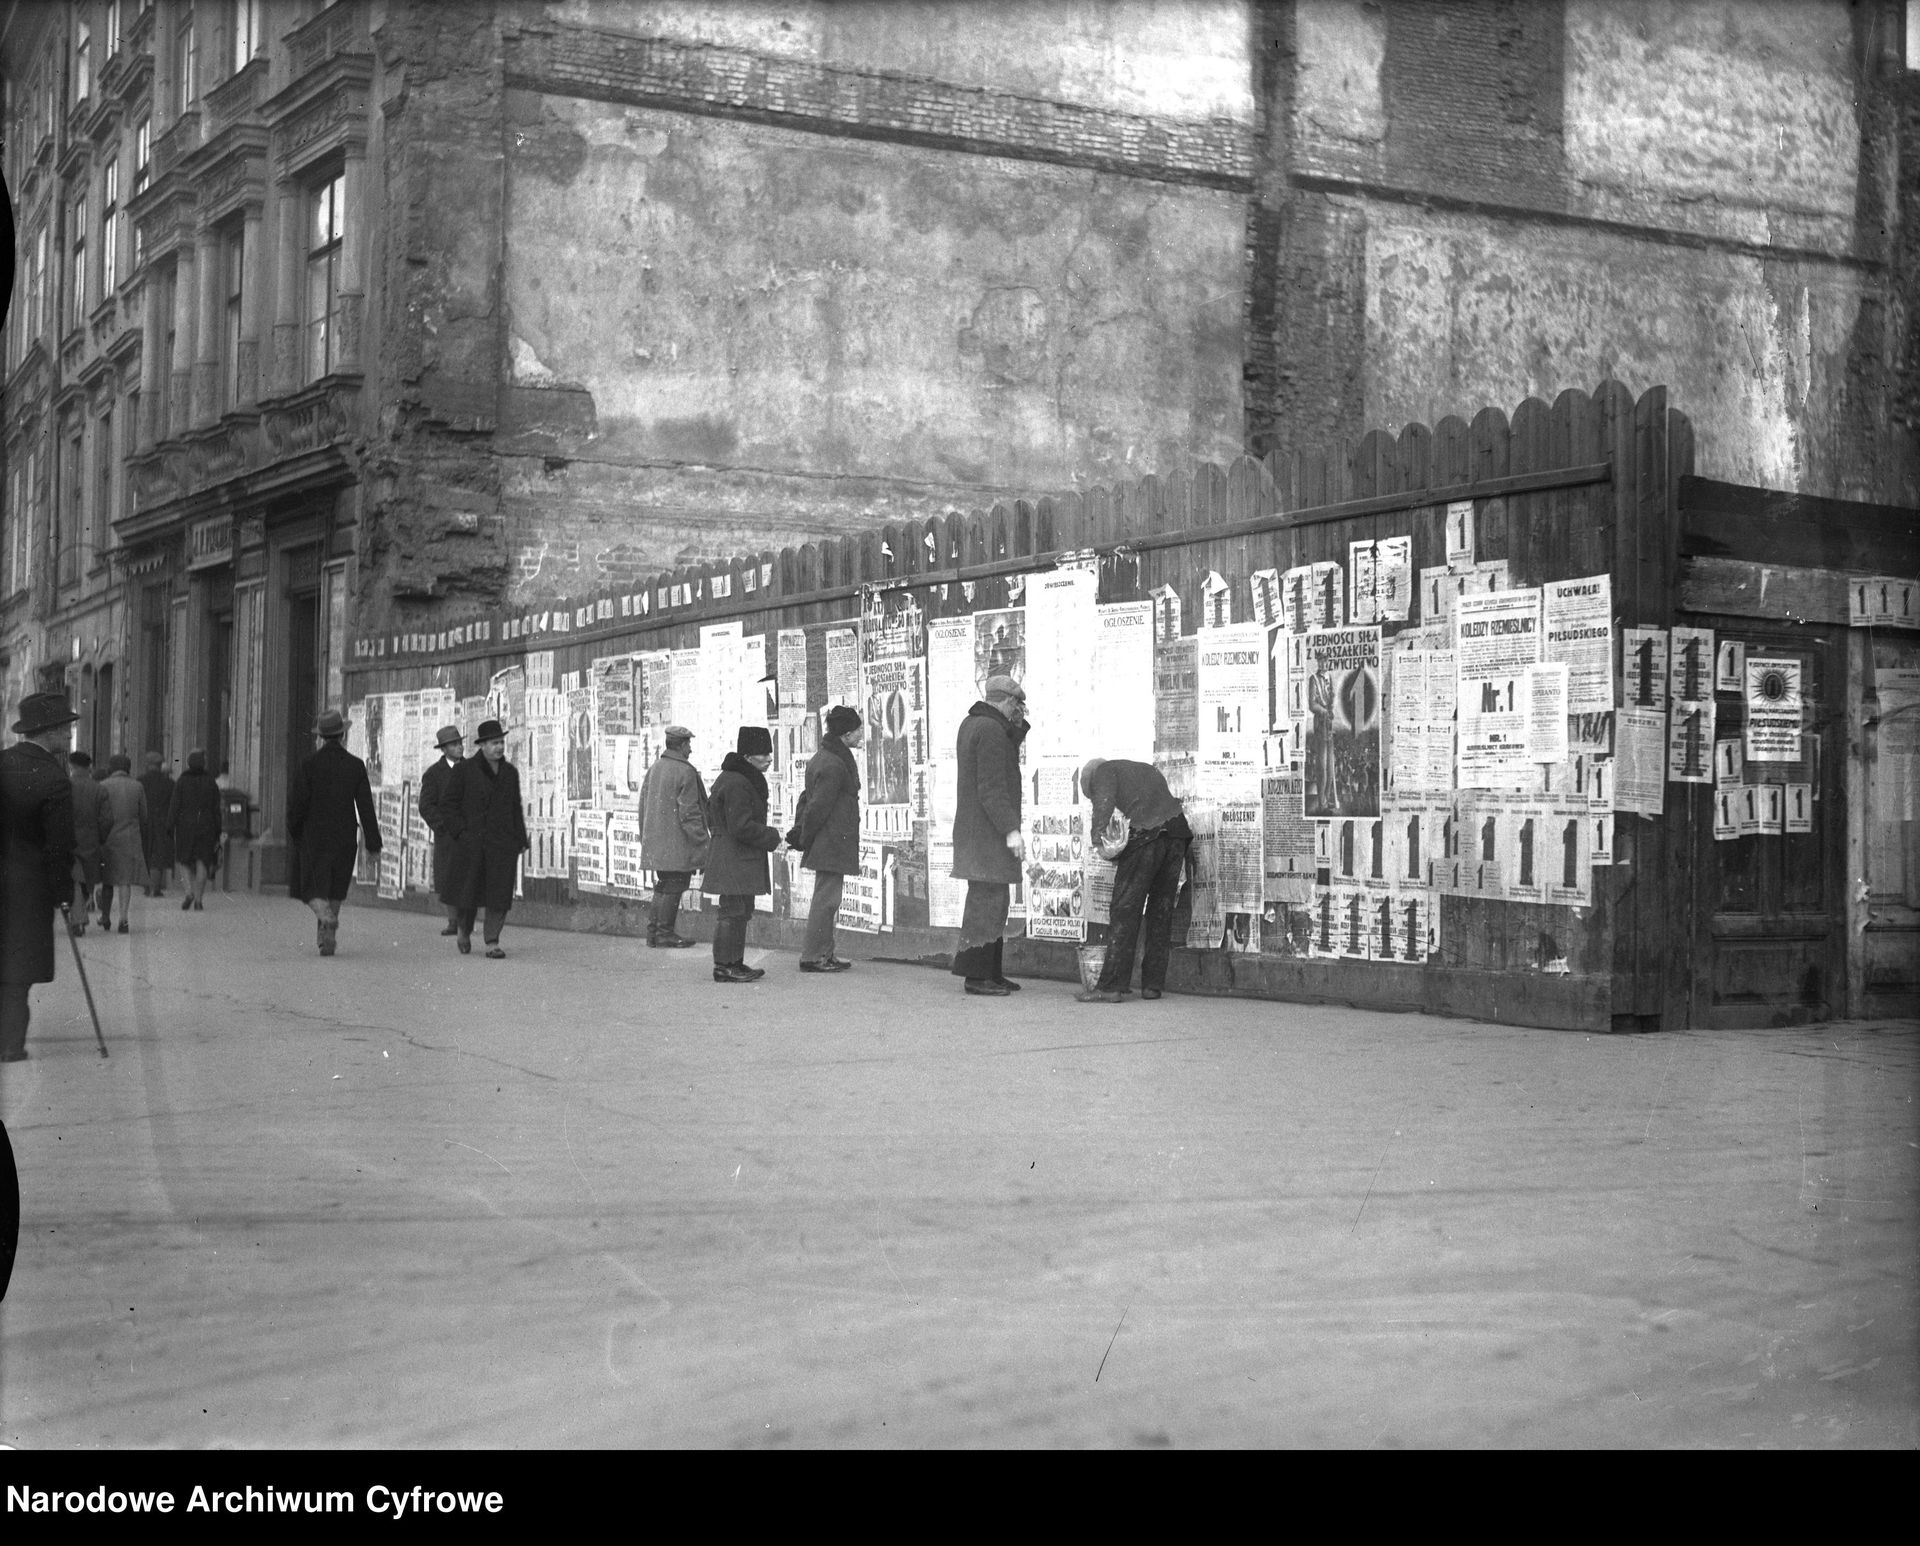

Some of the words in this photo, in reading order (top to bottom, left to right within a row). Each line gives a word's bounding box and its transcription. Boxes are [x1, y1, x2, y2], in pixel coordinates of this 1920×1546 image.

[1258, 577, 1276, 627] 1
[1292, 574, 1308, 634] 1
[1322, 568, 1336, 629] 1
[1306, 648, 1312, 660] Z
[1312, 631, 1354, 647] JEDNOŚCI
[1358, 630, 1379, 643] SIŁA
[1460, 621, 1488, 638] KOLEDZY
[1548, 626, 1608, 642] PIŁSUDSKIEGO
[1482, 682, 1504, 712] Nr.
[1508, 680, 1514, 712] 1
[1634, 637, 1656, 706] 1
[1682, 636, 1703, 702] 1
[1218, 706, 1232, 732] Nr.
[1237, 706, 1241, 732] 1
[1680, 708, 1704, 776] 1
[1032, 768, 1038, 805] 1
[1072, 767, 1079, 804] 1
[1408, 815, 1420, 879] 1
[1520, 818, 1534, 886] 1
[1563, 819, 1578, 888] 1
[1318, 892, 1332, 953] 1
[1346, 893, 1362, 954] 1
[1378, 896, 1394, 958] 1
[1404, 898, 1420, 961] 1
